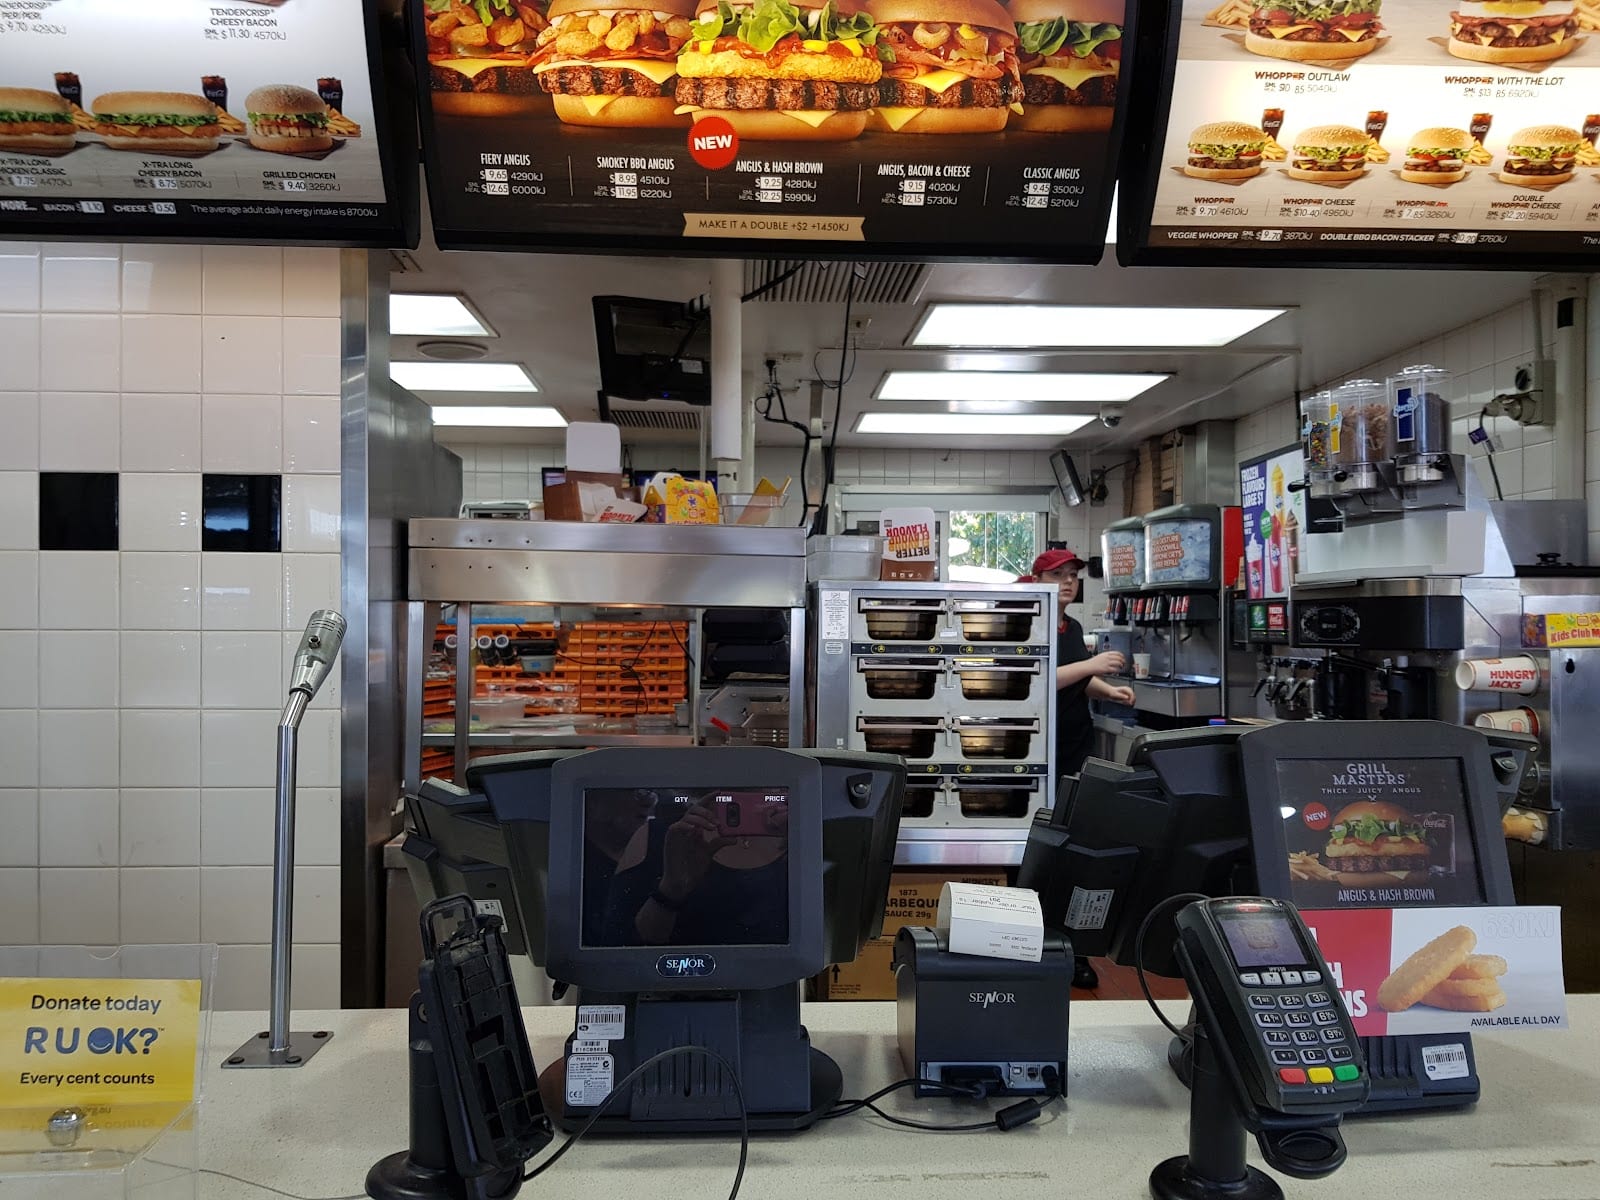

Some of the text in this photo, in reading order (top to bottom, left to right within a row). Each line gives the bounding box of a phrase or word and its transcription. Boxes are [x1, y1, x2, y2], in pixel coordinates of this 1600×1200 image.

[210, 18, 278, 27] CHEESY BACON
[1254, 71, 1351, 81] WHOPPER OUTLAW
[1444, 76, 1565, 86] WHOPPER WITH THE LOT
[693, 134, 733, 151] NEW
[480, 153, 531, 166] FIERY ANGUS
[596, 156, 675, 170] SMOKEY BBQ ANGUS
[142, 161, 168, 169] X-TRA
[735, 160, 824, 174] ANGUS & HASH BROWN
[262, 171, 336, 180] GRILLED CHICKEN
[877, 164, 972, 178] ANGUS, BACON & CHEESE
[1023, 167, 1081, 180] CLASSIC ANGUS
[510, 172, 544, 182] 4290kJ
[639, 176, 670, 185] 4510kJ
[784, 180, 817, 189] 4280kJ
[927, 183, 961, 192] 4020kJ
[511, 186, 547, 195] 6000kJ
[640, 189, 672, 198] 6220kJ
[784, 193, 817, 202] 5990kJ
[926, 196, 958, 205] 5730kJ
[1050, 198, 1080, 207] 5210kJ
[1324, 198, 1356, 206] CHEESE
[1512, 194, 1545, 202] DOUBLE
[113, 204, 148, 213] CHEESE
[191, 204, 379, 218] The average adult daily energy intake is 8700kJ
[698, 220, 850, 232] MAKE IT A DOUBLE +$2 +1450KJ
[1167, 231, 1198, 239] VEGGIE
[1198, 232, 1239, 240] WHOPPER
[1320, 233, 1353, 241] DOUBLE
[1353, 233, 1371, 241] BBQ
[1371, 234, 1400, 242] BACON
[1399, 234, 1435, 242] STACKER
[886, 523, 928, 538] FLAVOUR
[895, 546, 930, 559] BETTER
[1550, 630, 1570, 644] Kids
[1571, 628, 1591, 639] Club
[1489, 670, 1536, 680] HUNGRY
[1346, 763, 1390, 774] GRILL
[1332, 774, 1406, 785] MASTERS
[674, 796, 689, 804] QTY
[1305, 810, 1328, 823] NEW
[1338, 888, 1436, 902] ANGUS & HASH BROWN
[884, 910, 932, 919] SAUCE 29g
[666, 957, 705, 974] SENOR
[31, 994, 162, 1015] Donate today
[968, 991, 1016, 1009] SENOR
[1470, 1015, 1561, 1027] AVAILABLE ALL DAY
[24, 1027, 48, 1055] R
[55, 1027, 80, 1055] U
[20, 1072, 156, 1088] Every cent counts
